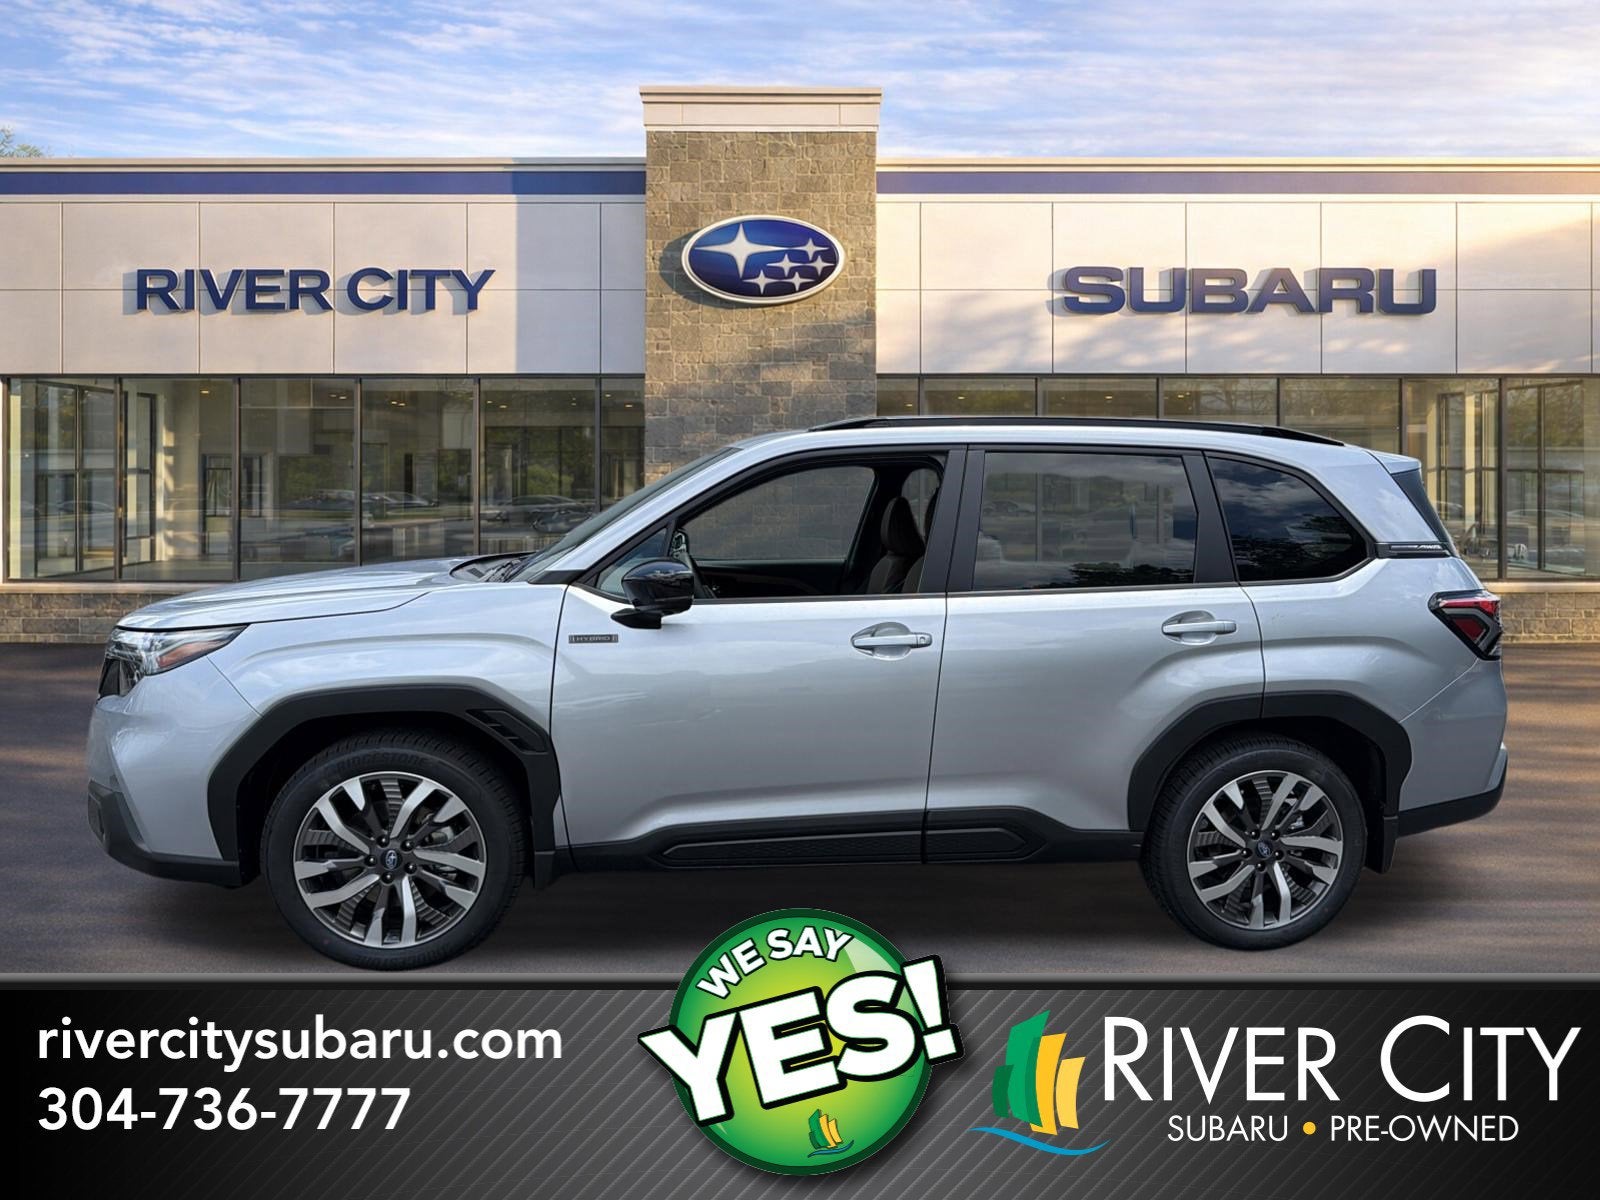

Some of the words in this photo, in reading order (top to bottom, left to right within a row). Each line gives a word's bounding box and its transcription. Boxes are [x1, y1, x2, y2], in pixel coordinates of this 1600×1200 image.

[136, 268, 333, 311] RIVER
[347, 267, 496, 311] CITY
[1062, 266, 1438, 315] SUBARU
[328, 752, 433, 776] RIDGESTONE
